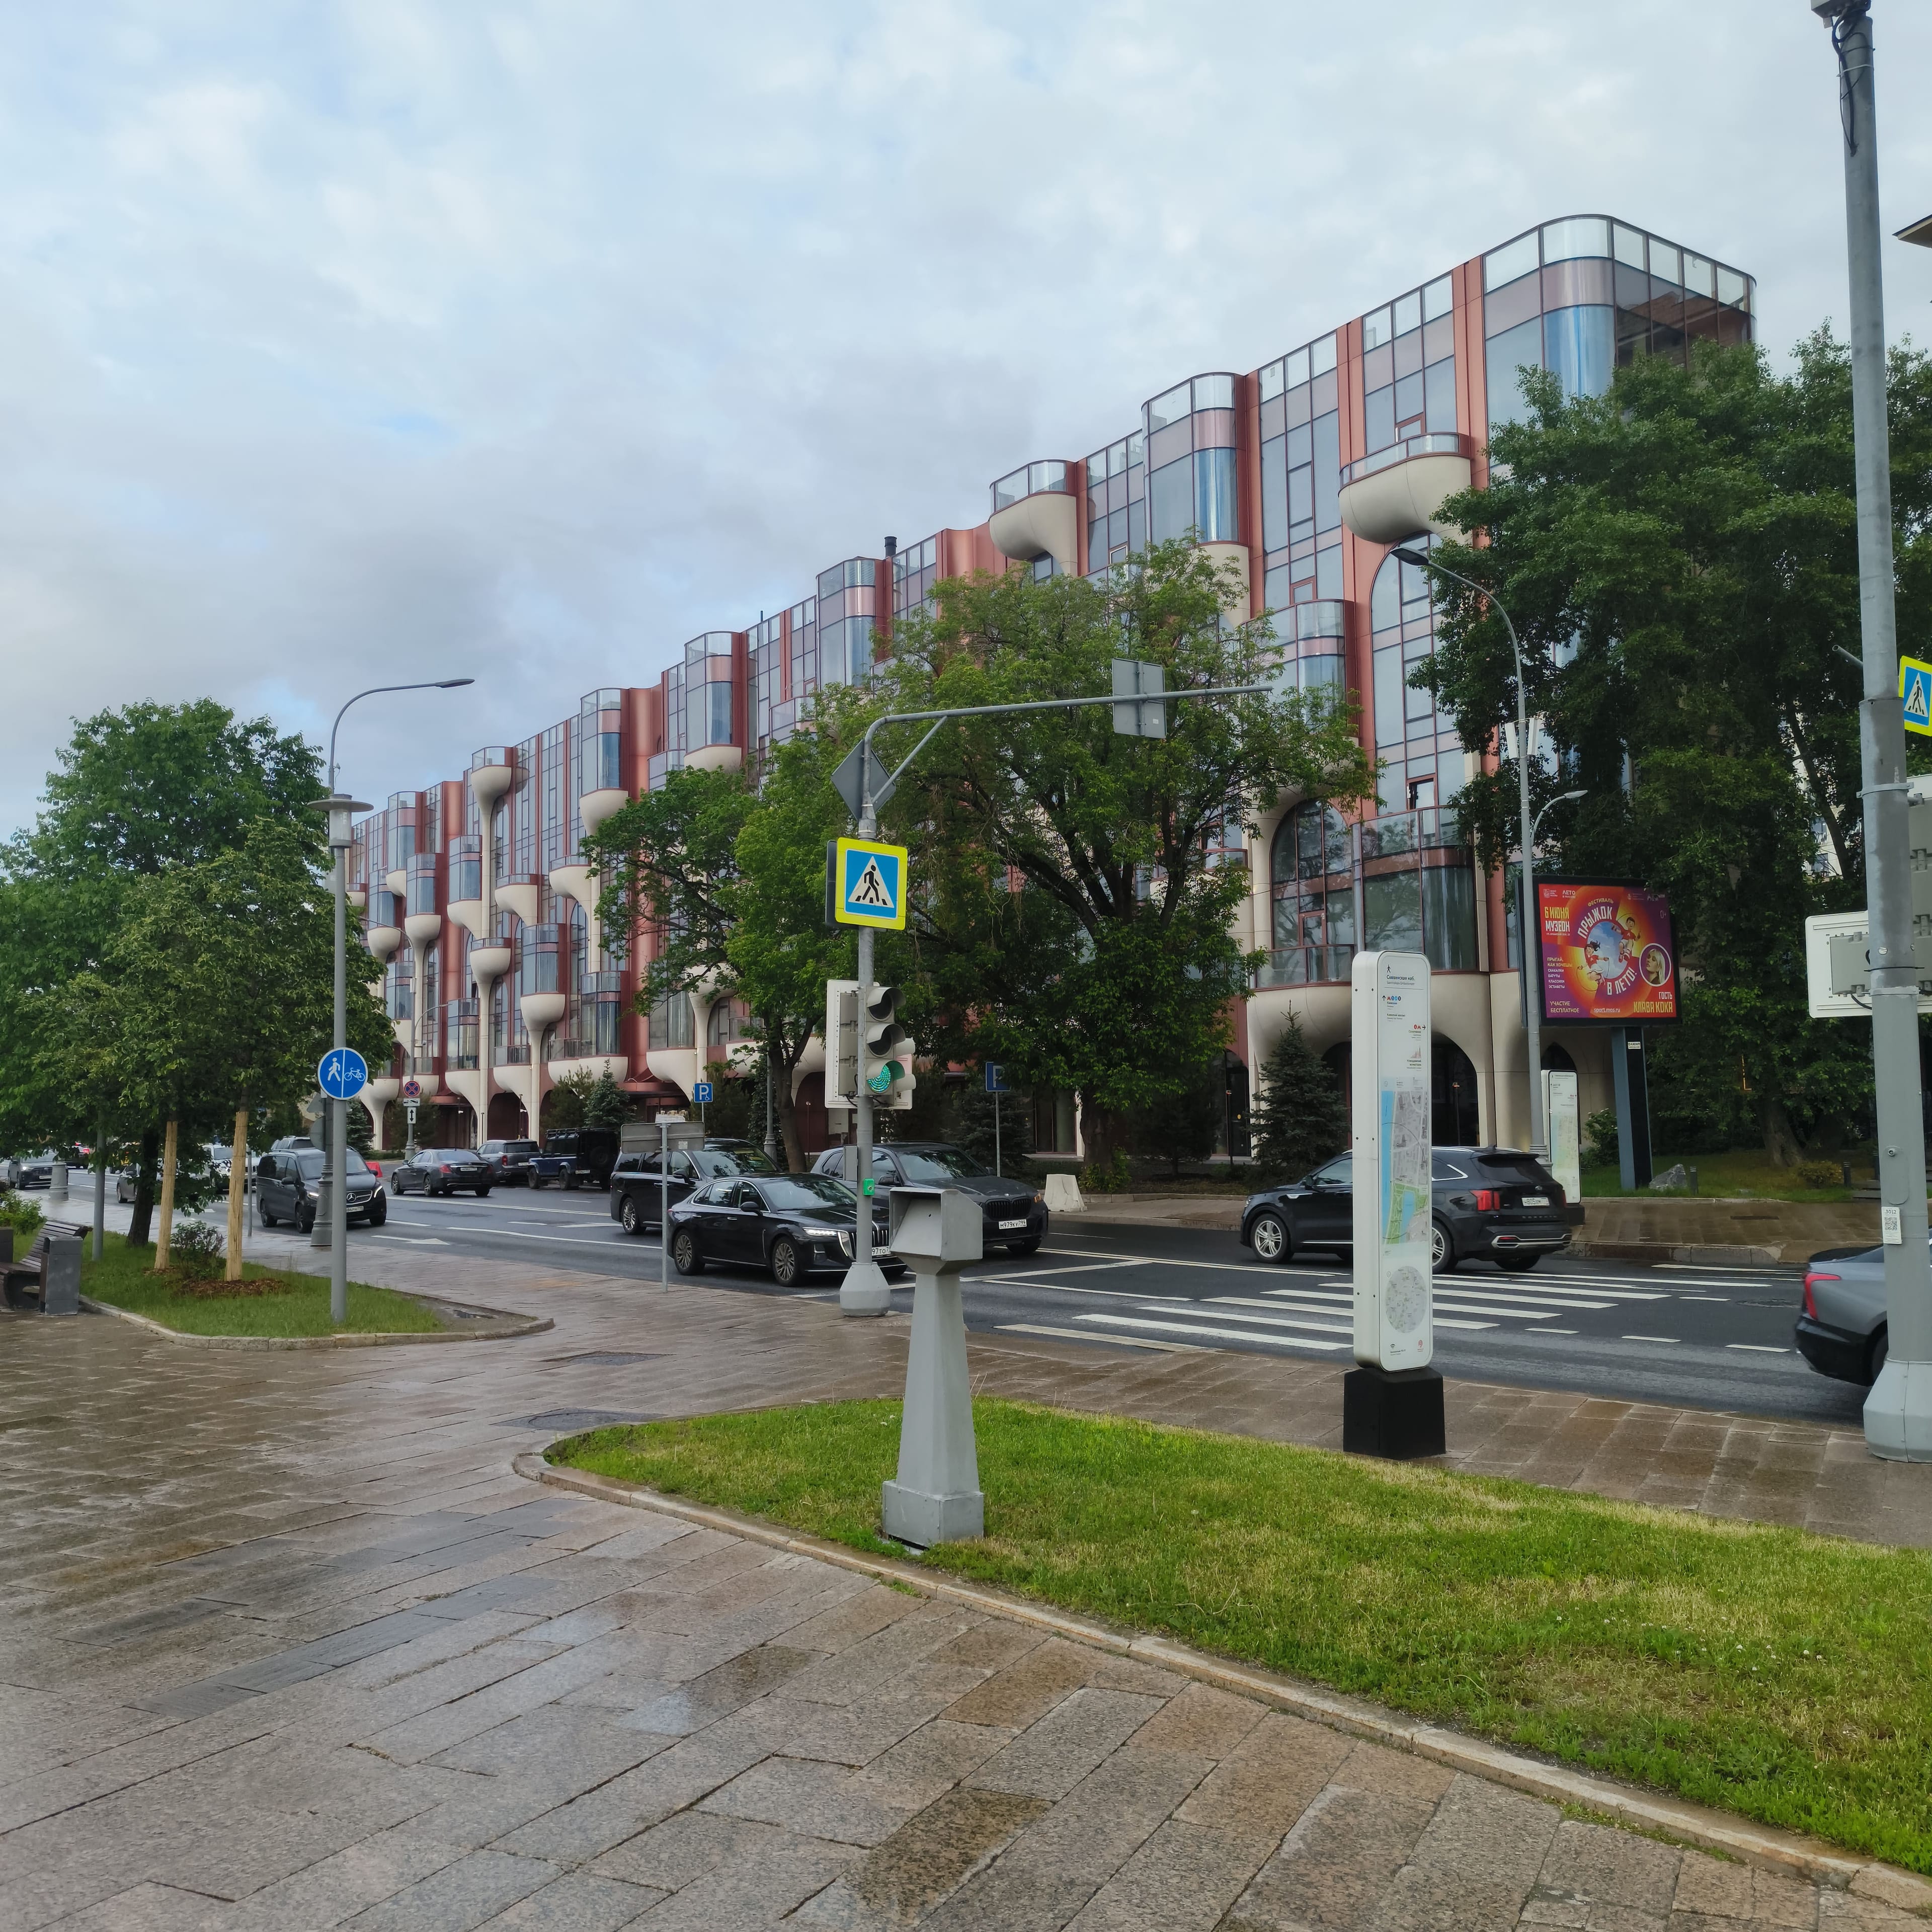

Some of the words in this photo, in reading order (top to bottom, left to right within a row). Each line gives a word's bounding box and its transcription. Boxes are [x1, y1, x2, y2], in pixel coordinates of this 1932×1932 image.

[1588, 898, 1614, 906] ФЕСТИВАЛЬ
[1544, 907, 1549, 918] 6
[1550, 907, 1569, 919] ИЮНЯ
[1546, 920, 1570, 932] МУЗЕОН
[1578, 906, 1612, 939] ПРЫЖОК
[1607, 982, 1612, 995] В
[1615, 967, 1637, 994] ЛЕТО!
[1634, 1001, 1654, 1013] КЛАВА
[1655, 1001, 1673, 1013] КОКА
[699, 1085, 709, 1100] P
